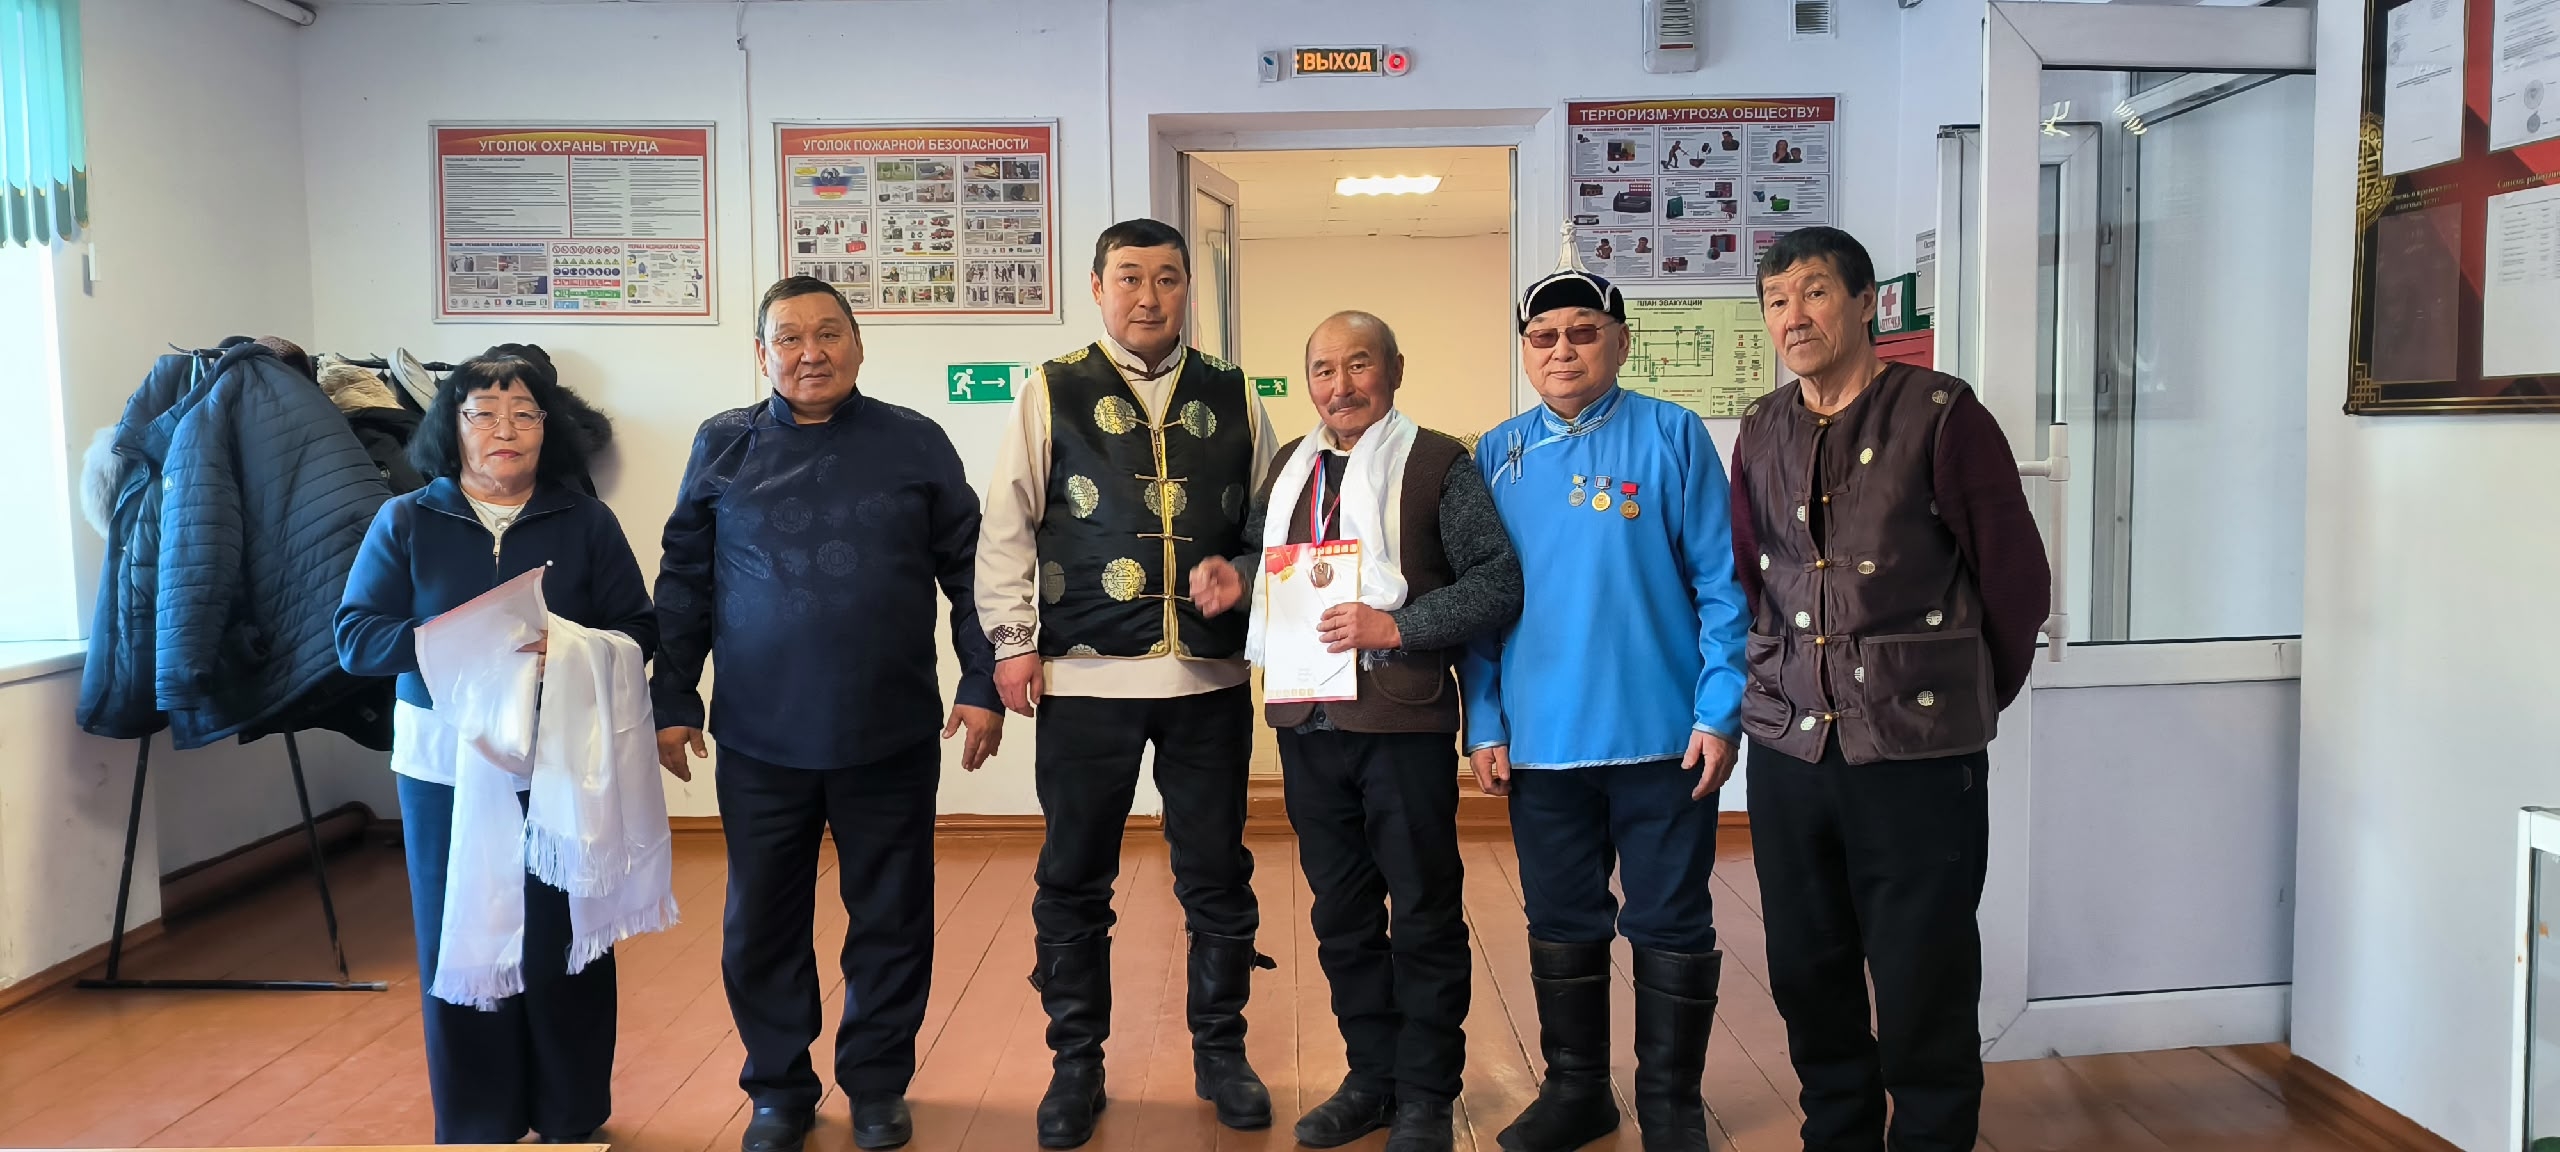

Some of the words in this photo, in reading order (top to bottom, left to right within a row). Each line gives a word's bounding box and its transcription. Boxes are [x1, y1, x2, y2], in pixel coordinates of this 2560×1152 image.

[1303, 52, 1372, 71] ВЫХОД
[1580, 107, 1728, 121] ТЕРРОРИЗМ-УГРОЗА
[1732, 106, 1820, 121] ОБЩЕСТВУ!
[479, 140, 538, 152] УГОЛОК
[541, 140, 606, 152] ОХРАНЫ
[610, 140, 659, 154] ТРУДА
[803, 139, 852, 151] УГОЛОК
[854, 137, 925, 151] ПОЖАРНОЙ
[928, 138, 1029, 150] БЕЗОПАСНОСТИ
[1659, 299, 1703, 307] ЭВАКУАЦИИ
